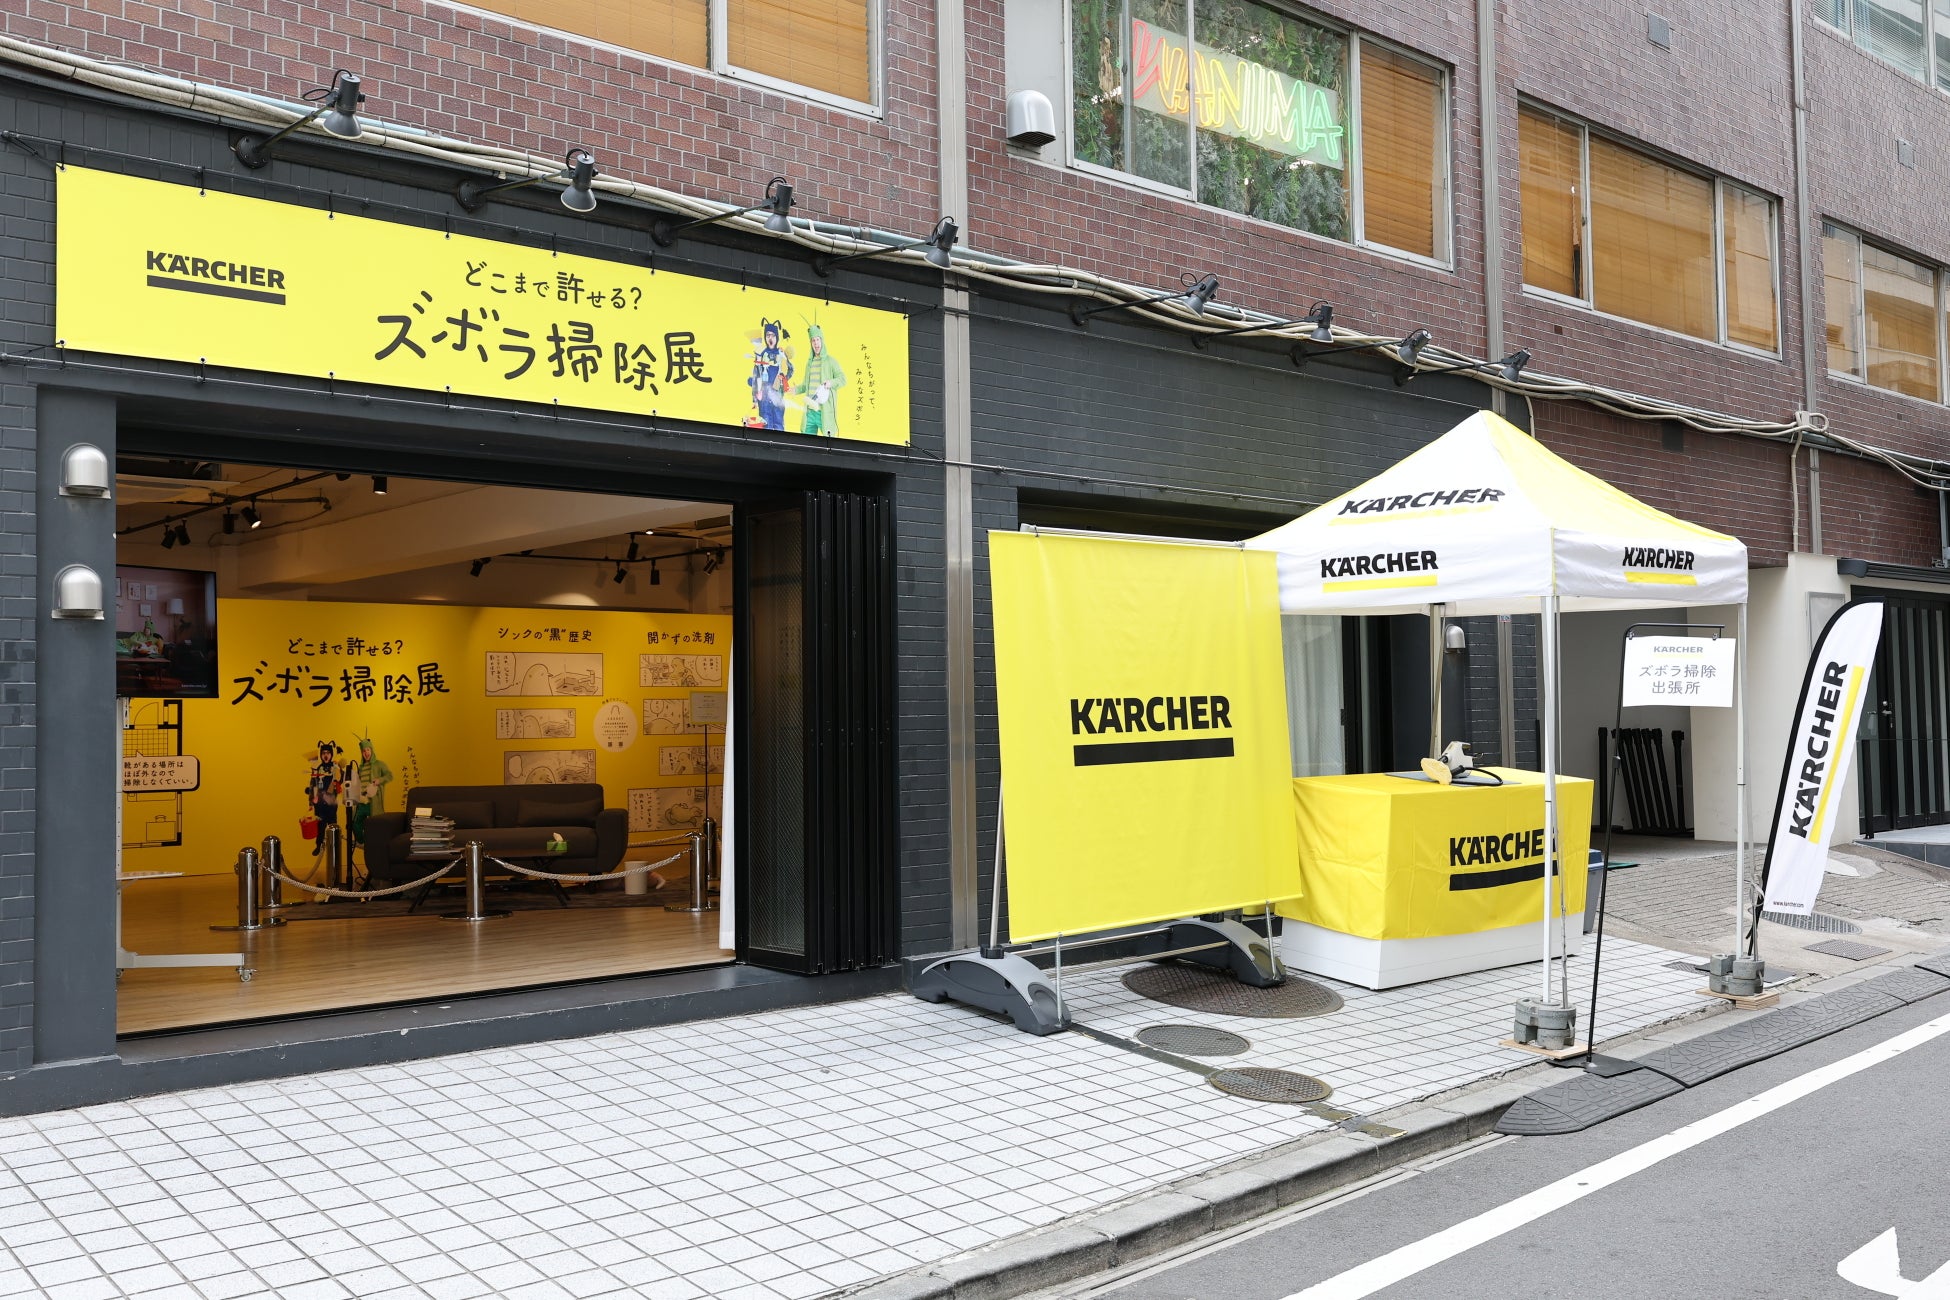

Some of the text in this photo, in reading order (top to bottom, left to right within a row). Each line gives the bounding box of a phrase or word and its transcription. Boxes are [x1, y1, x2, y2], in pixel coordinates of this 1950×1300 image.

[1132, 18, 1344, 161] WANIMA
[146, 250, 286, 291] KÄRCHER
[375, 291, 713, 396] ズボラ掃除展
[1337, 487, 1506, 517] KÄRCHER
[1321, 550, 1439, 578] KÄRCHER
[1622, 546, 1695, 571] KÄRCHER
[647, 631, 715, 645] 開かずの洗剤
[232, 661, 450, 707] ズボラ掃除展
[1639, 664, 1717, 678] ズボラ掃除
[1652, 680, 1701, 695] 出張所
[1071, 696, 1233, 735] KÄRCHER
[124, 761, 184, 769] 靴がある場所は
[1789, 660, 1848, 839] KÄRCHER
[1450, 827, 1556, 867] KÄRCHE
